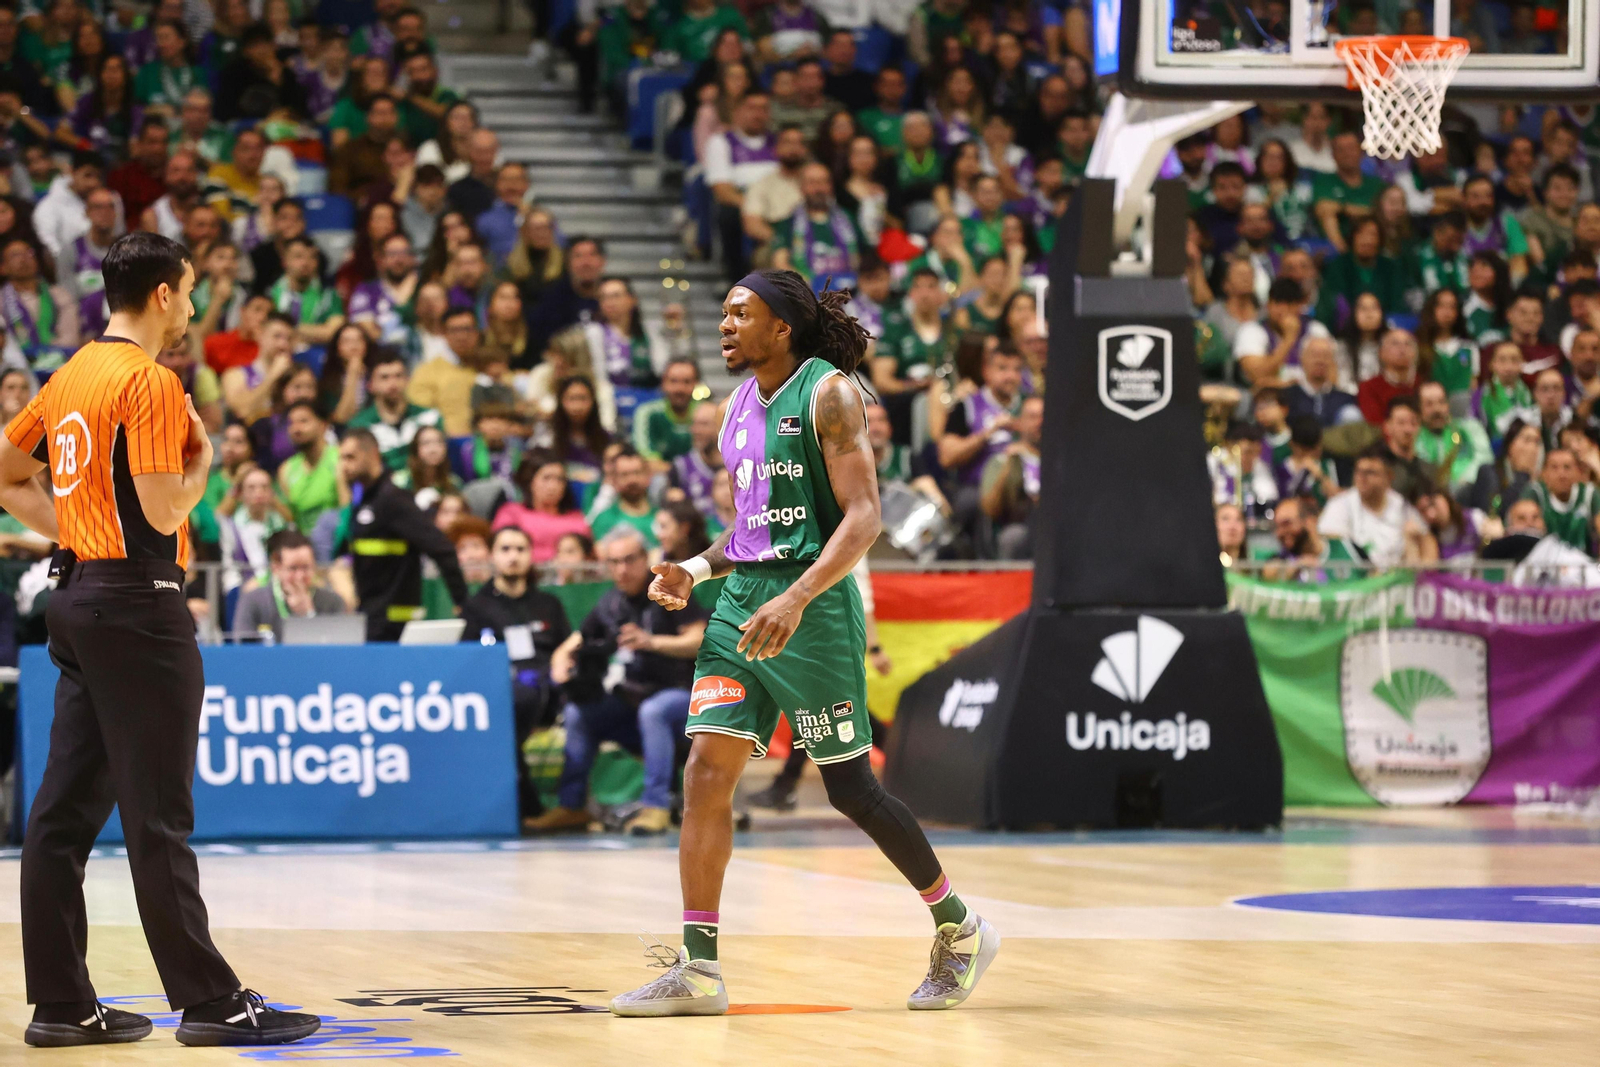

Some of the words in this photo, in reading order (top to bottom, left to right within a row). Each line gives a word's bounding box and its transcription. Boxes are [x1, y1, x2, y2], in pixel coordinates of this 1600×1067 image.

[56, 433, 78, 475] 78
[747, 504, 806, 530] máaga
[199, 680, 490, 735] Fundación
[835, 707, 849, 716] acb
[1066, 710, 1211, 761] Unicaja
[197, 732, 411, 798] Unicaja
